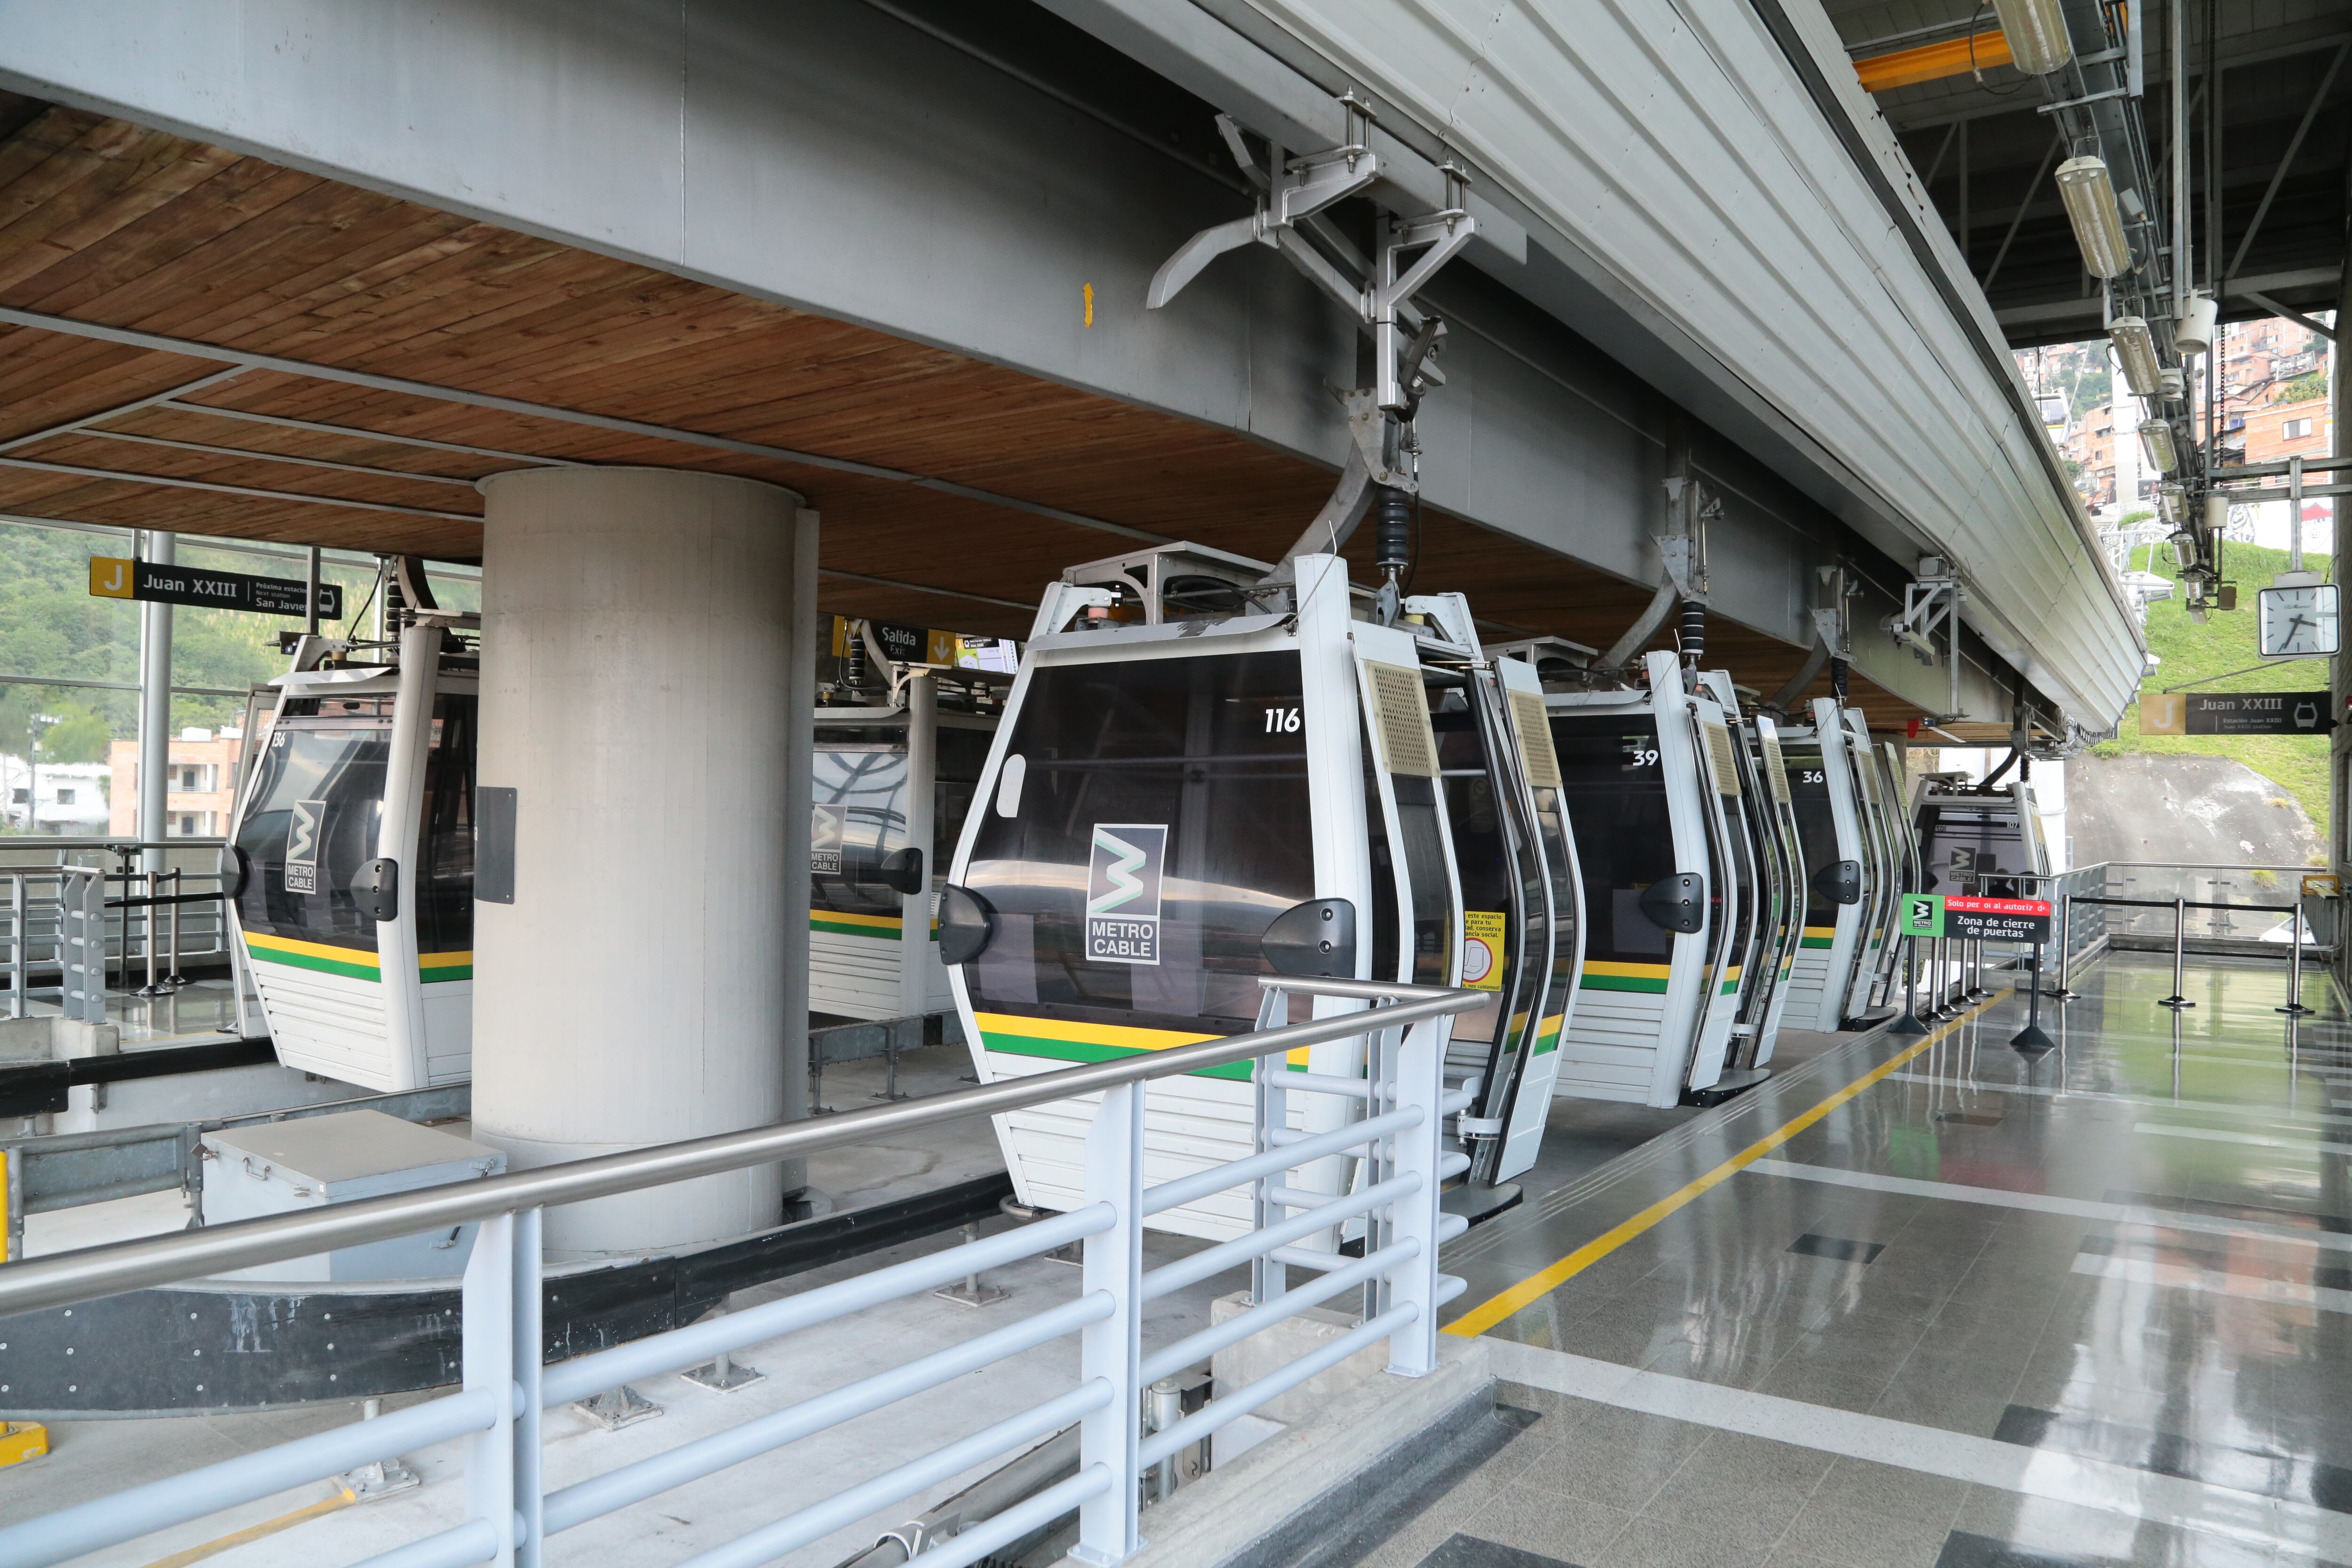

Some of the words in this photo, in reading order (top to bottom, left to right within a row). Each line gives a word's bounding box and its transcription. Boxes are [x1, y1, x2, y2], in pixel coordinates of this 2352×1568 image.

[104, 565, 122, 590] J
[143, 574, 185, 592] Juan
[192, 579, 237, 597] XXIII
[256, 582, 282, 590] Próxima
[256, 597, 274, 608] San
[882, 627, 916, 646] Salida
[2200, 699, 2235, 710] Juan
[2241, 698, 2283, 709] XXIII
[1265, 708, 1300, 732] 116
[2153, 701, 2173, 729] J
[272, 732, 286, 747] 136
[1633, 750, 1658, 766] 39
[1803, 771, 1823, 783] 36
[811, 853, 838, 861] METRO
[288, 865, 313, 877] METRO
[812, 862, 837, 870] CABLE
[288, 876, 313, 889] CABLE
[1957, 916, 1982, 926] Zona
[1986, 918, 1999, 927] de
[2003, 919, 2035, 929] cierre
[1092, 922, 1153, 940] METRO
[1967, 926, 1979, 935] de
[1984, 928, 2024, 938] puertas
[1094, 939, 1151, 957] CABLE
